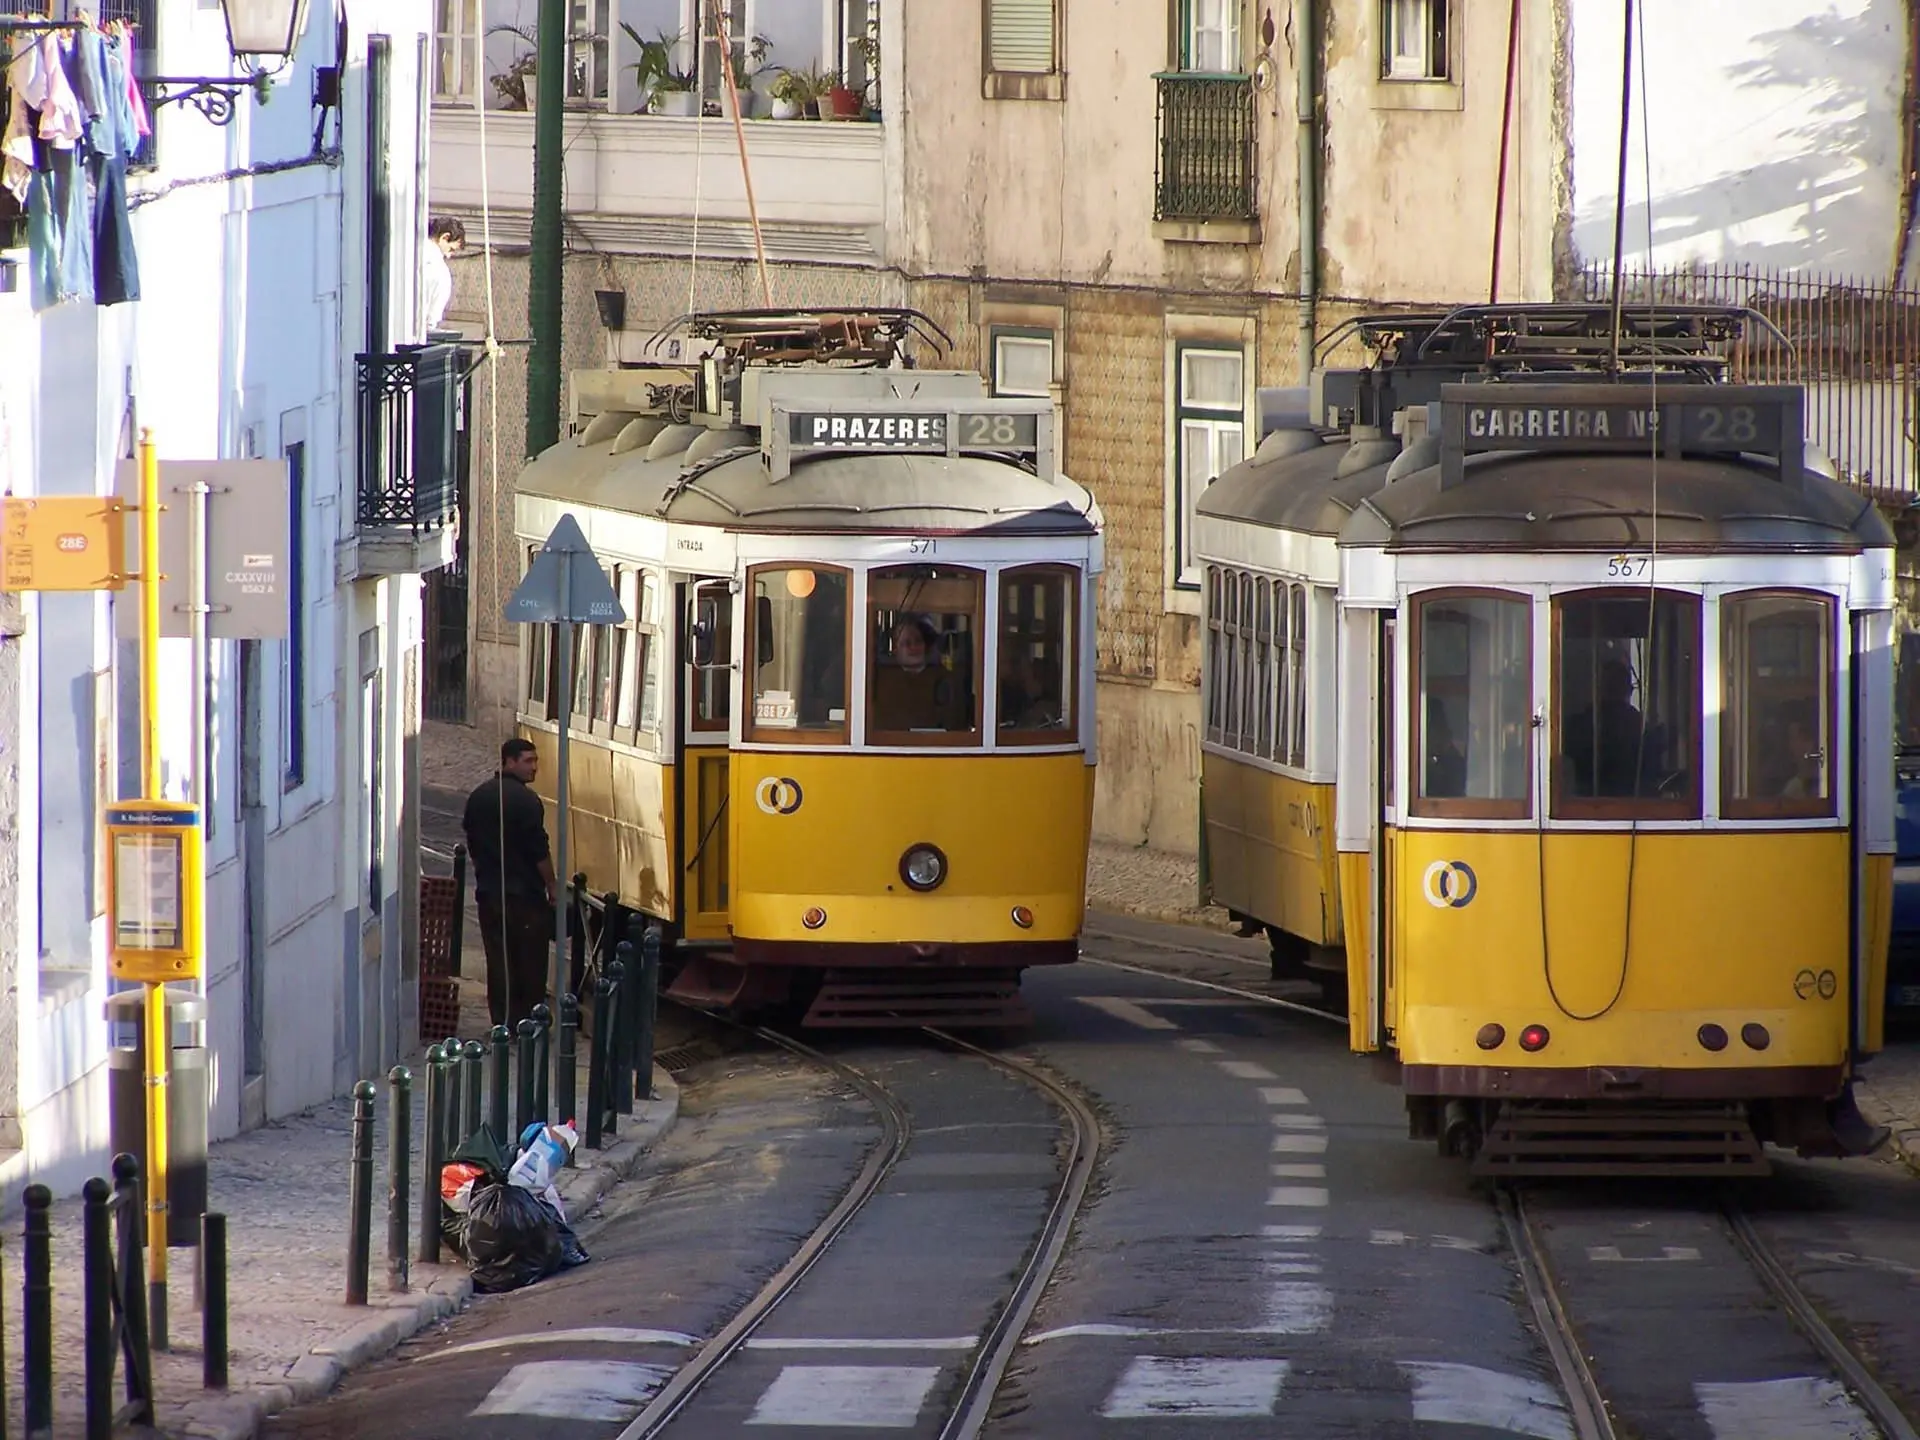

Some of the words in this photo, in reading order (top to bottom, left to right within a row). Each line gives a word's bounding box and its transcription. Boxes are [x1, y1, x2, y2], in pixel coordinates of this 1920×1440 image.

[813, 416, 946, 439] PRAZERES
[967, 414, 1017, 445] 28
[1469, 408, 1610, 438] CARREIRA
[1697, 406, 1758, 444] 28
[59, 536, 85, 550] 28E
[677, 538, 704, 553] ENTRADA
[909, 538, 937, 555] 571
[1608, 557, 1648, 578] 567
